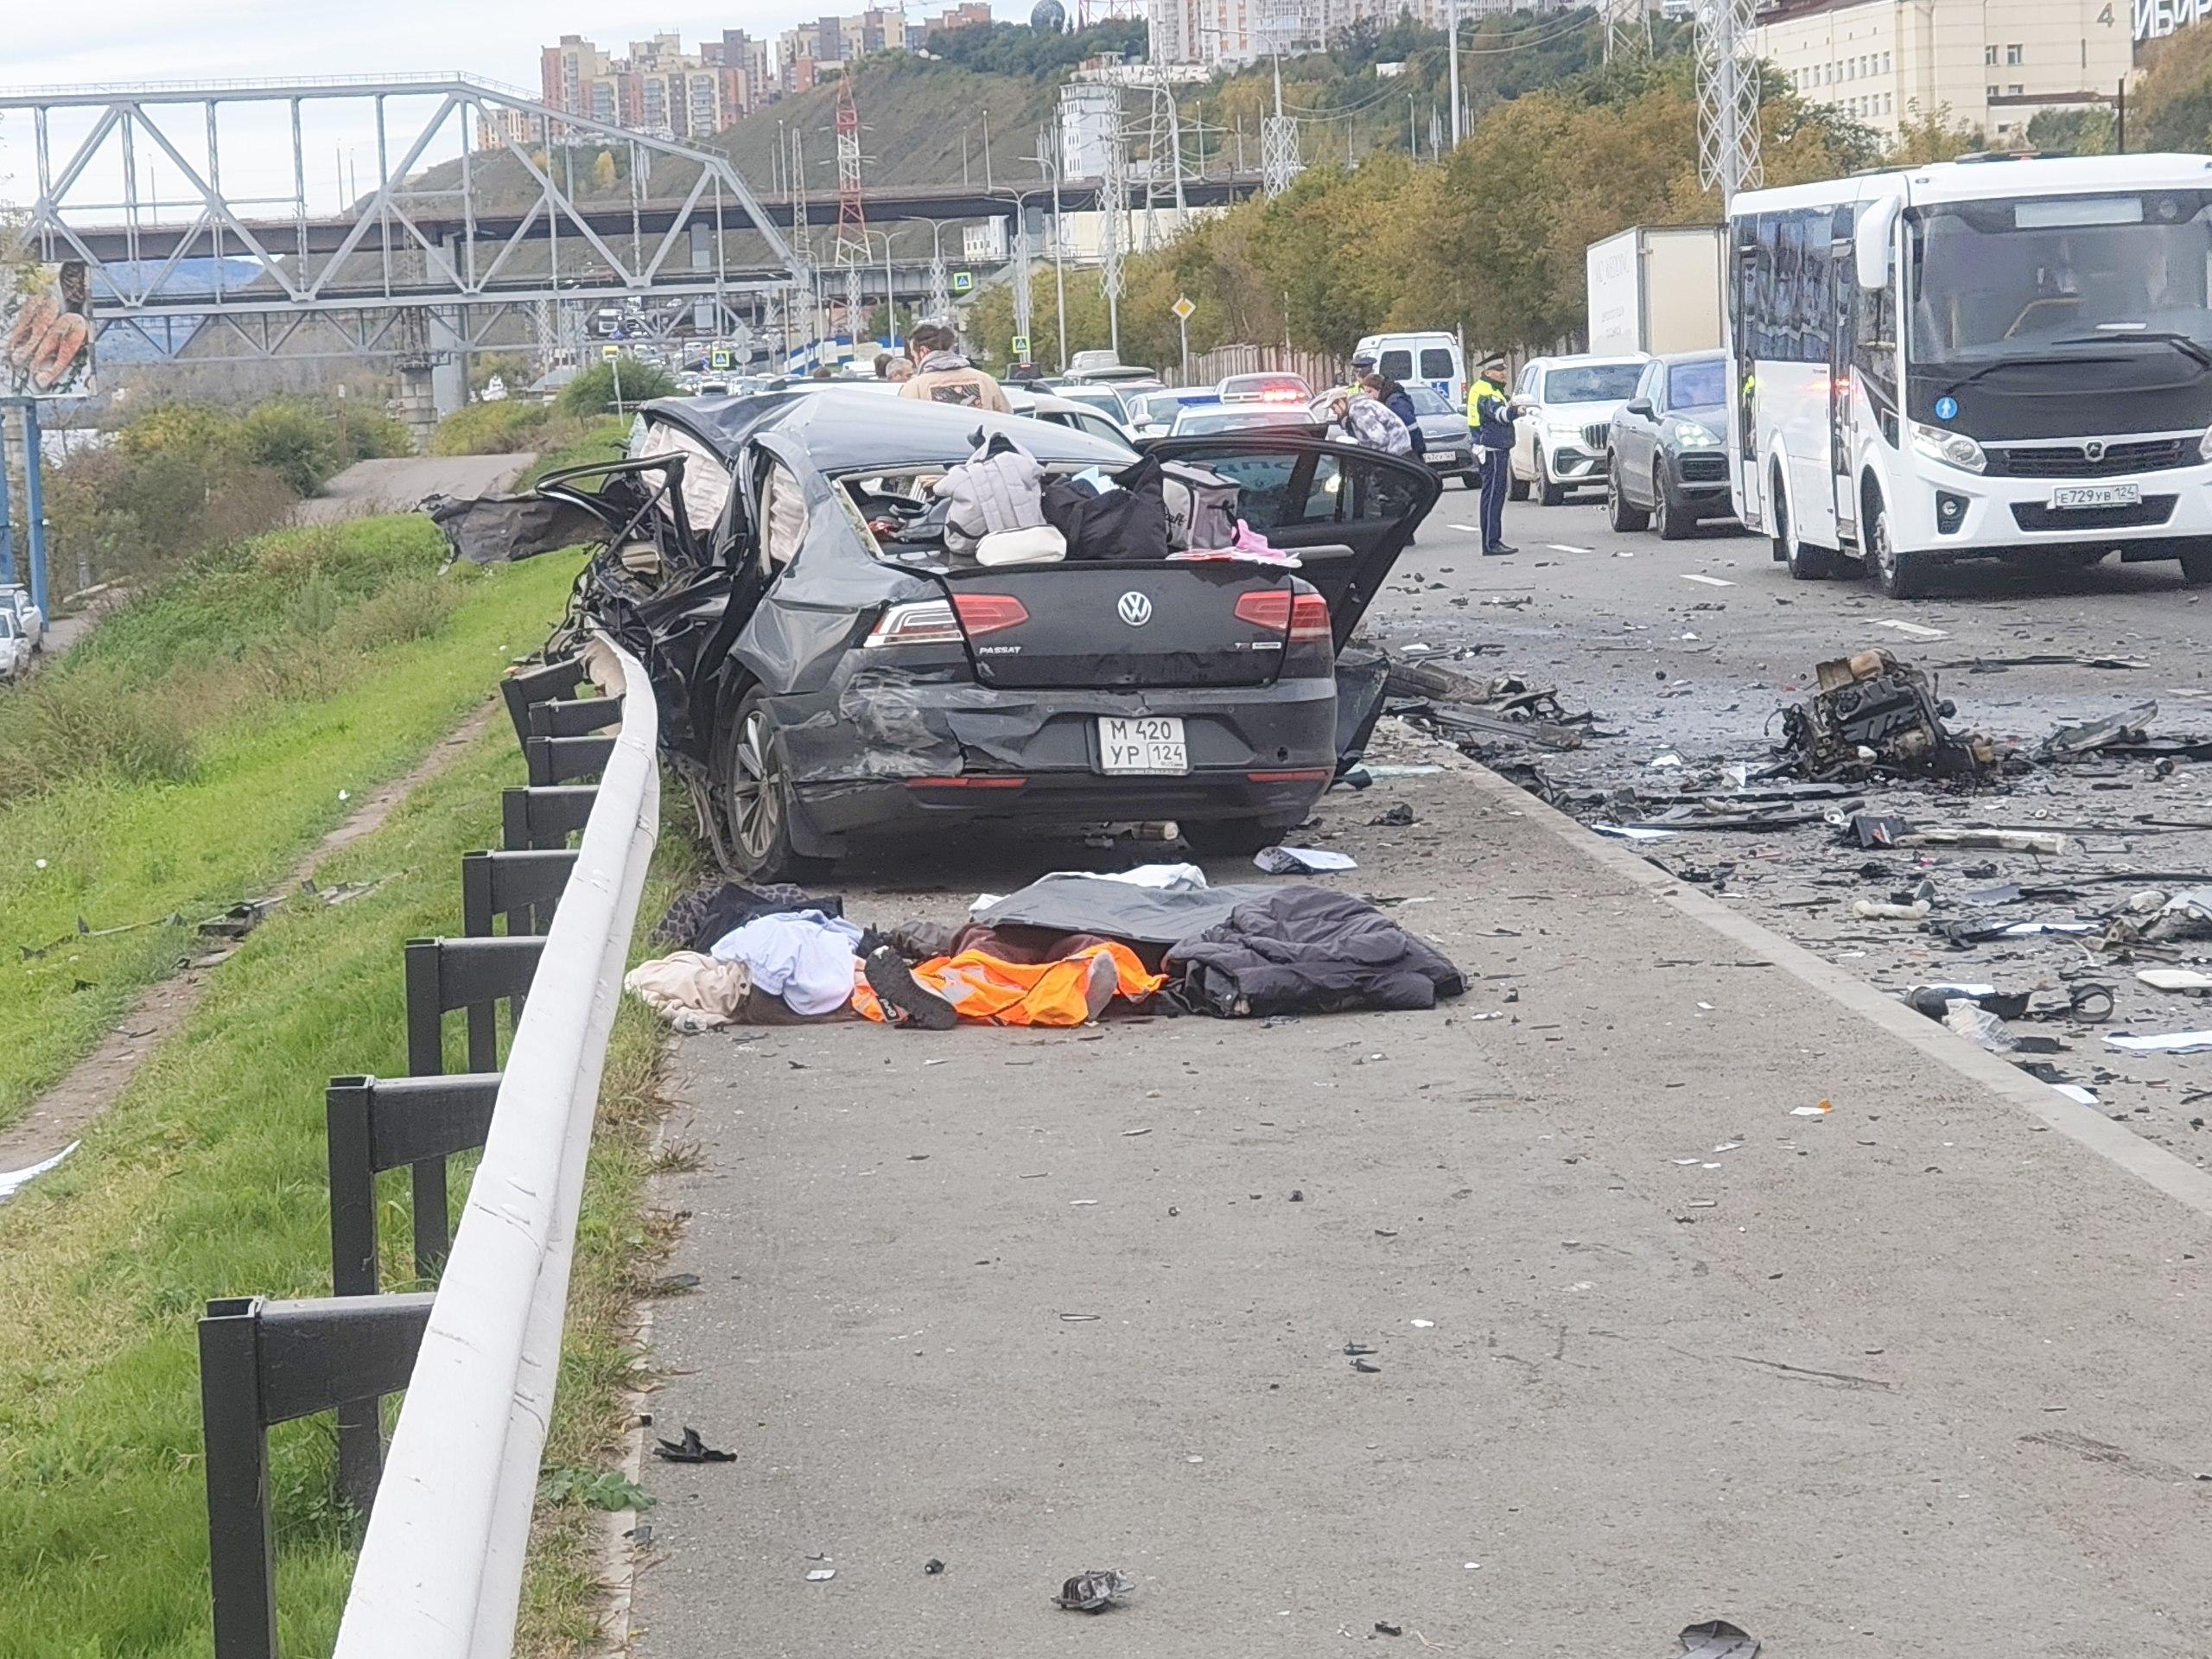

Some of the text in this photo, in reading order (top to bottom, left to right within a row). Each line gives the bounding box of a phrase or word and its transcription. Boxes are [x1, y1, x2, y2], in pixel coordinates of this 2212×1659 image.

[2096, 3, 2115, 28] 4
[978, 646, 1022, 655] PASSAT
[1135, 720, 1172, 741] 420
[1110, 745, 1141, 766] УР
[1152, 745, 1183, 761] 124
